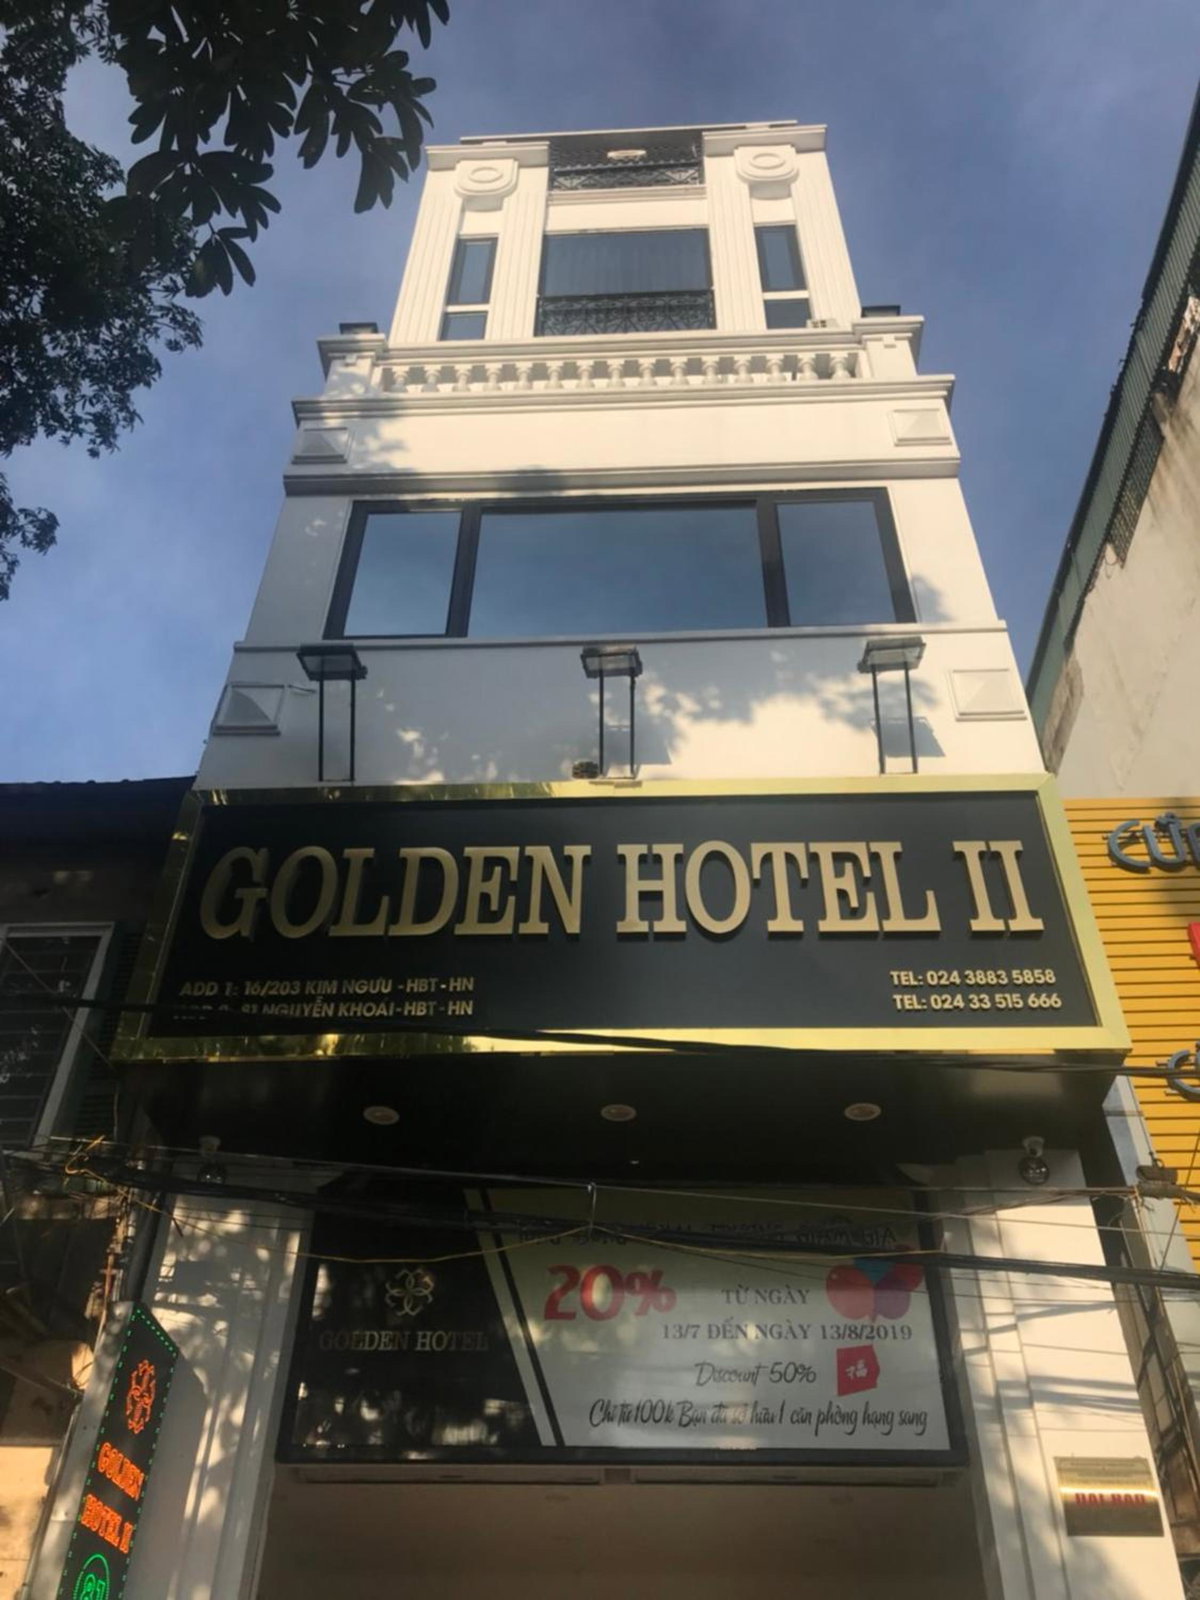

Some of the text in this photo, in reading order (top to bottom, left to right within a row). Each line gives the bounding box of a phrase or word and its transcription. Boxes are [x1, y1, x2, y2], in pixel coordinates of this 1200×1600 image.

[200, 839, 1045, 939] GOLDEN HOTEL II
[179, 982, 219, 997] ADD
[244, 980, 301, 997] 16/203
[305, 980, 338, 995] KIM
[890, 969, 1056, 986] TEL: 024 3883 5858
[894, 993, 1063, 1010] TEL: 024 33 515 666
[543, 1263, 678, 1322] 20%
[721, 1283, 811, 1305] TỪ NGÀY
[319, 1329, 490, 1352] GOLDEN HOTEL
[662, 1316, 913, 1341] 13/7 ĐẾN NGÀY 13/8/2019
[694, 1360, 818, 1388] Discount 50%
[815, 1400, 858, 1437] phòng
[898, 1409, 928, 1436] sang
